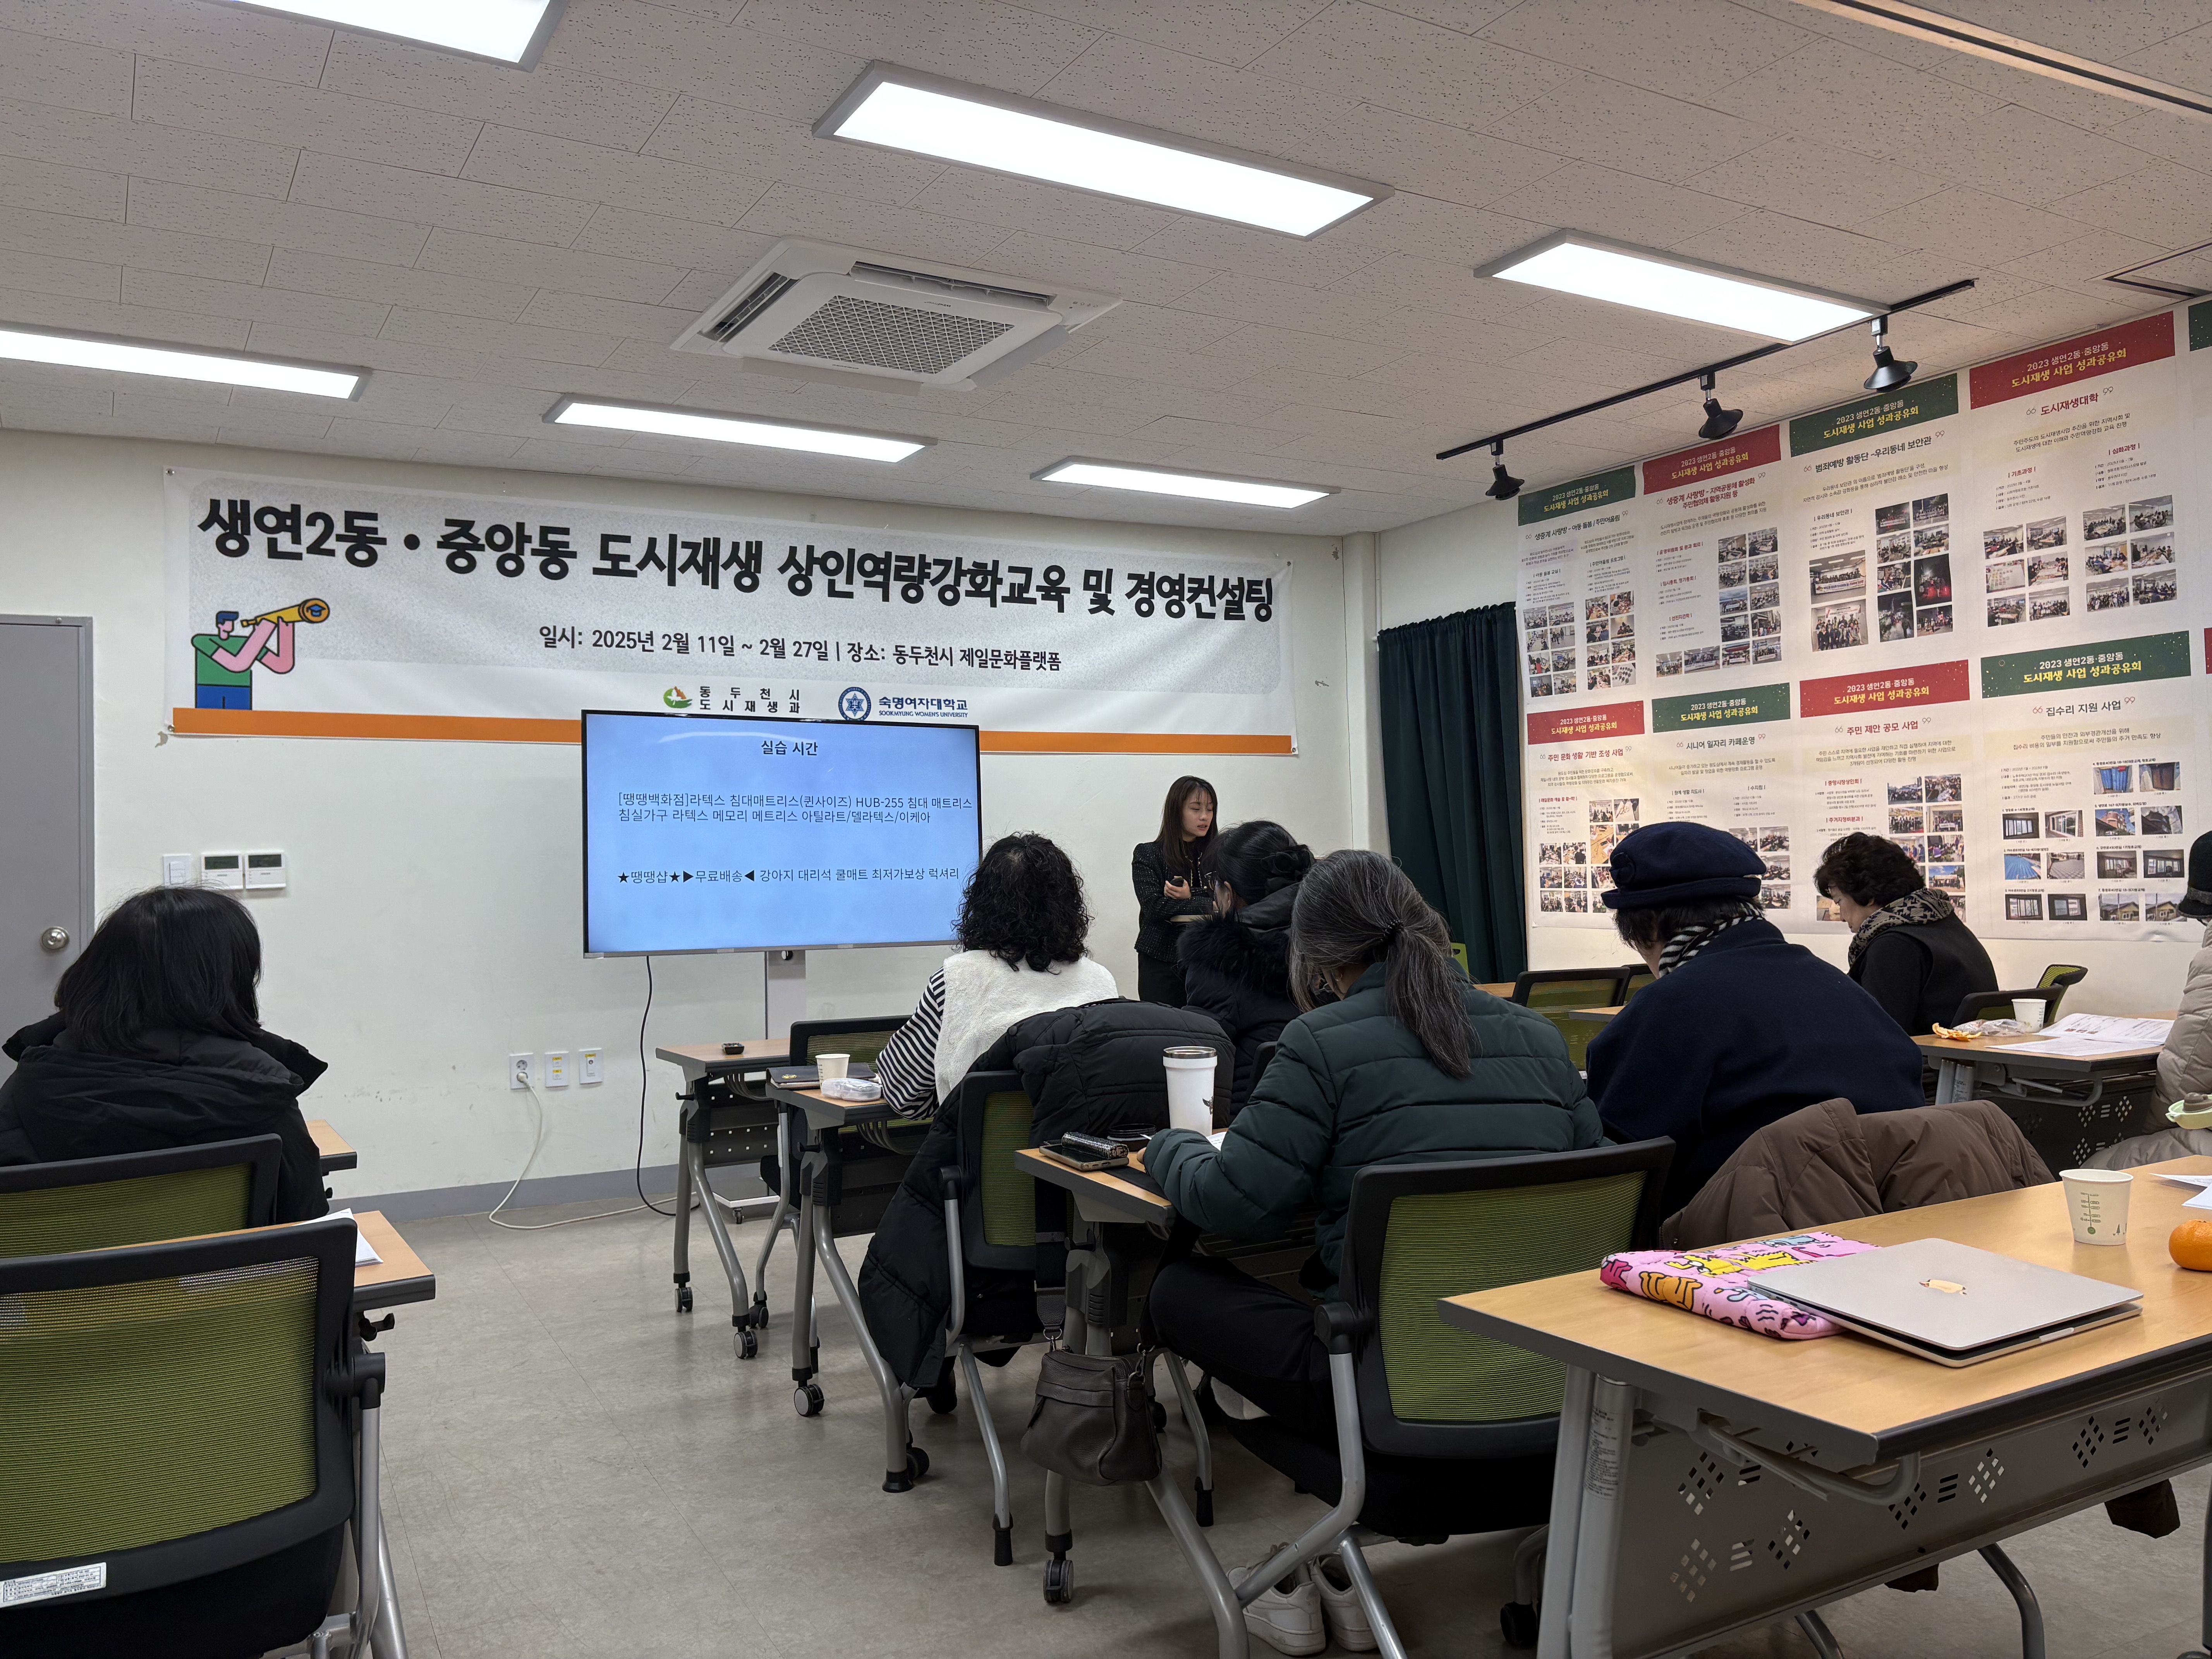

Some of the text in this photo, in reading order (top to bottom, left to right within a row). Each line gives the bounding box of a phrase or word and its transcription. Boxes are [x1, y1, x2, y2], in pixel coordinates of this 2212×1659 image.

[2012, 348, 2126, 387] 도시재생 사업 성과공유회
[2027, 359, 2049, 371] 2023
[2041, 393, 2098, 415] 도시재생대학
[1824, 406, 1918, 438] 도시재생 사업 성과공유회
[1837, 414, 1854, 424] 2023
[1816, 459, 1844, 472] 범죄예방
[1846, 452, 1869, 465] 활동단
[1908, 436, 1931, 449] 보안관
[1672, 452, 1748, 479] 도시재생 사업 성과공유회
[1681, 458, 1695, 467] 2023
[1667, 477, 1755, 505] 생중계 사랑방 지역공동체 활성화
[1683, 497, 1708, 509] 주민협의체
[1710, 492, 1731, 503] 활동지원
[1535, 531, 1551, 540] 생중계
[1552, 527, 1567, 536] 사랑방
[1596, 515, 1620, 525] 주민어울림
[198, 499, 1272, 622] 생연2동 중앙동 도시재생 상인역량강화교육 및 경영컨설팅
[540, 625, 582, 648] 일시:
[592, 630, 654, 652] 2025년
[662, 633, 689, 654] 2월
[698, 635, 734, 656] 11일
[760, 638, 786, 659] 2월
[793, 641, 828, 661] 27일
[847, 642, 885, 662] 장소:
[893, 645, 953, 666] 동두천시
[960, 648, 1061, 671] 제일문화플랫폼
[2024, 661, 2141, 682] 도시재생 사업 성과공유회
[2040, 660, 2061, 669] 2023
[1834, 686, 1929, 704] 도시재생 사업 성과공유회
[1847, 684, 1865, 692] 2023
[879, 697, 967, 711] 숙명여자대학교
[2046, 701, 2121, 716] 집수리 지원 사업
[1681, 706, 1758, 721] 도시재생 사업 성과공유회
[1589, 721, 1617, 732] 성과공유회
[1847, 721, 1918, 735] 주민 제안 공모 사업
[761, 741, 818, 756] 실습 시간
[1686, 737, 1755, 750] 시니어 일자리 카페운영
[619, 793, 972, 809] [땡땡백화점]라텍스 침대매트리스(퀸사이즈) HUB-255 침대 매트리스
[619, 809, 930, 823] 침실가구 라텍스 메모리 메트리스 아틸라트/델라텍스/이케아
[761, 869, 793, 881] 강아지
[799, 869, 830, 881] 대리석
[836, 869, 868, 880] 쿨매트
[872, 868, 924, 880] 최저가보상
[929, 868, 958, 879] 럭셔리
